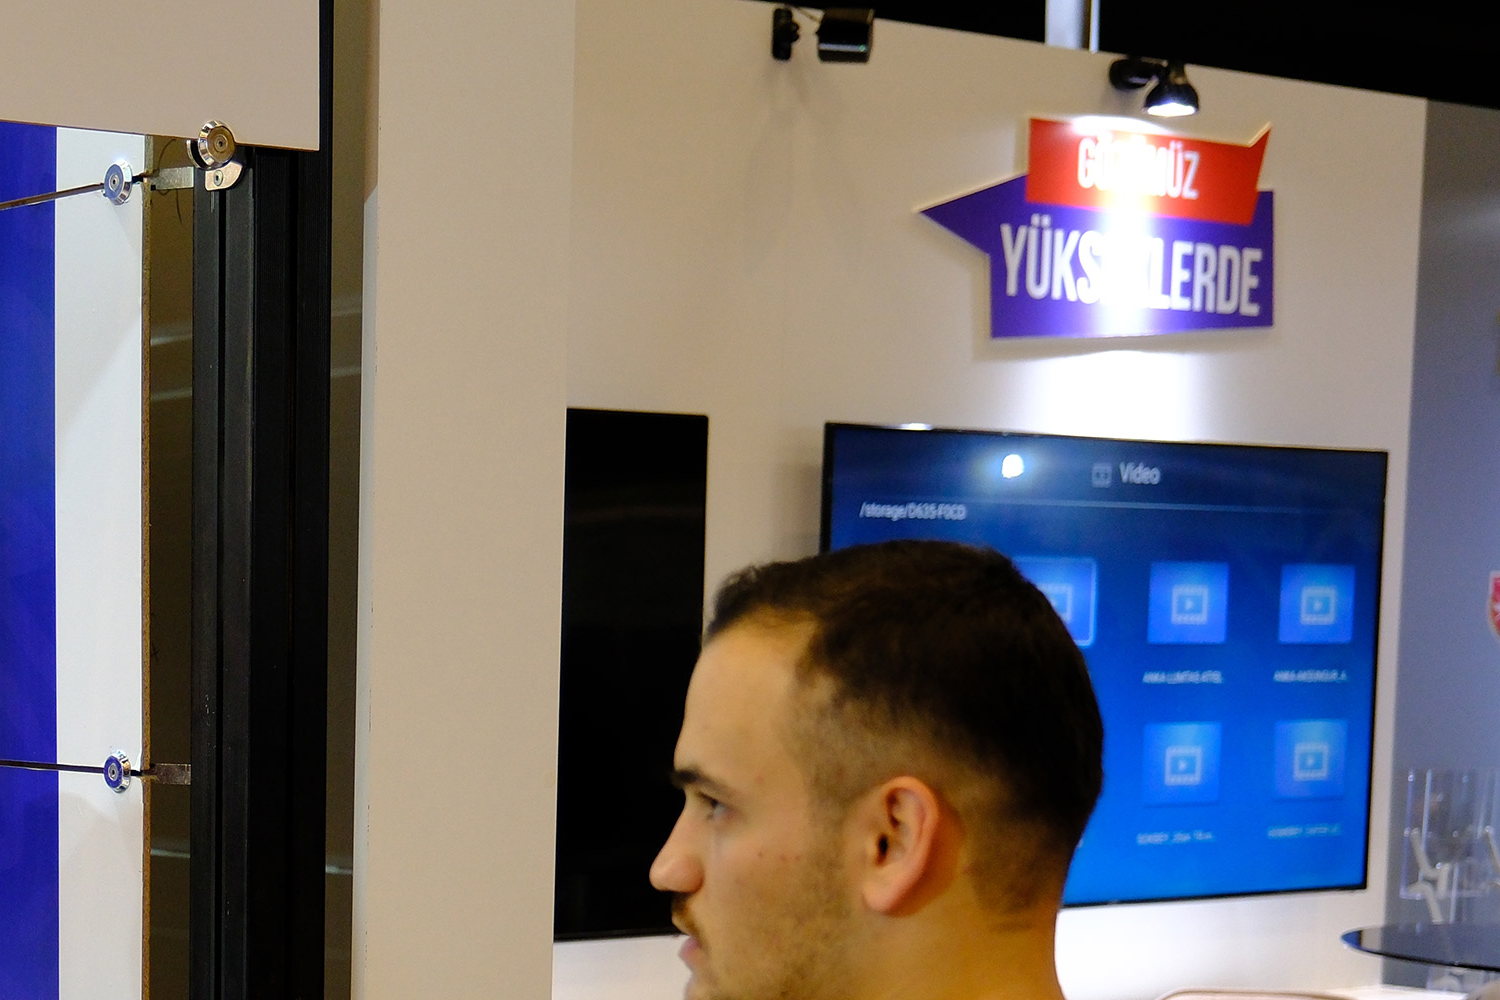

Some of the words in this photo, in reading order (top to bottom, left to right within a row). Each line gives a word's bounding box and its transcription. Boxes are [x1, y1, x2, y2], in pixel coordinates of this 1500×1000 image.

[1076, 137, 1200, 200] GÖMÜZ
[1000, 213, 1263, 316] YÜKSLERDE
[1119, 461, 1161, 485] Video
